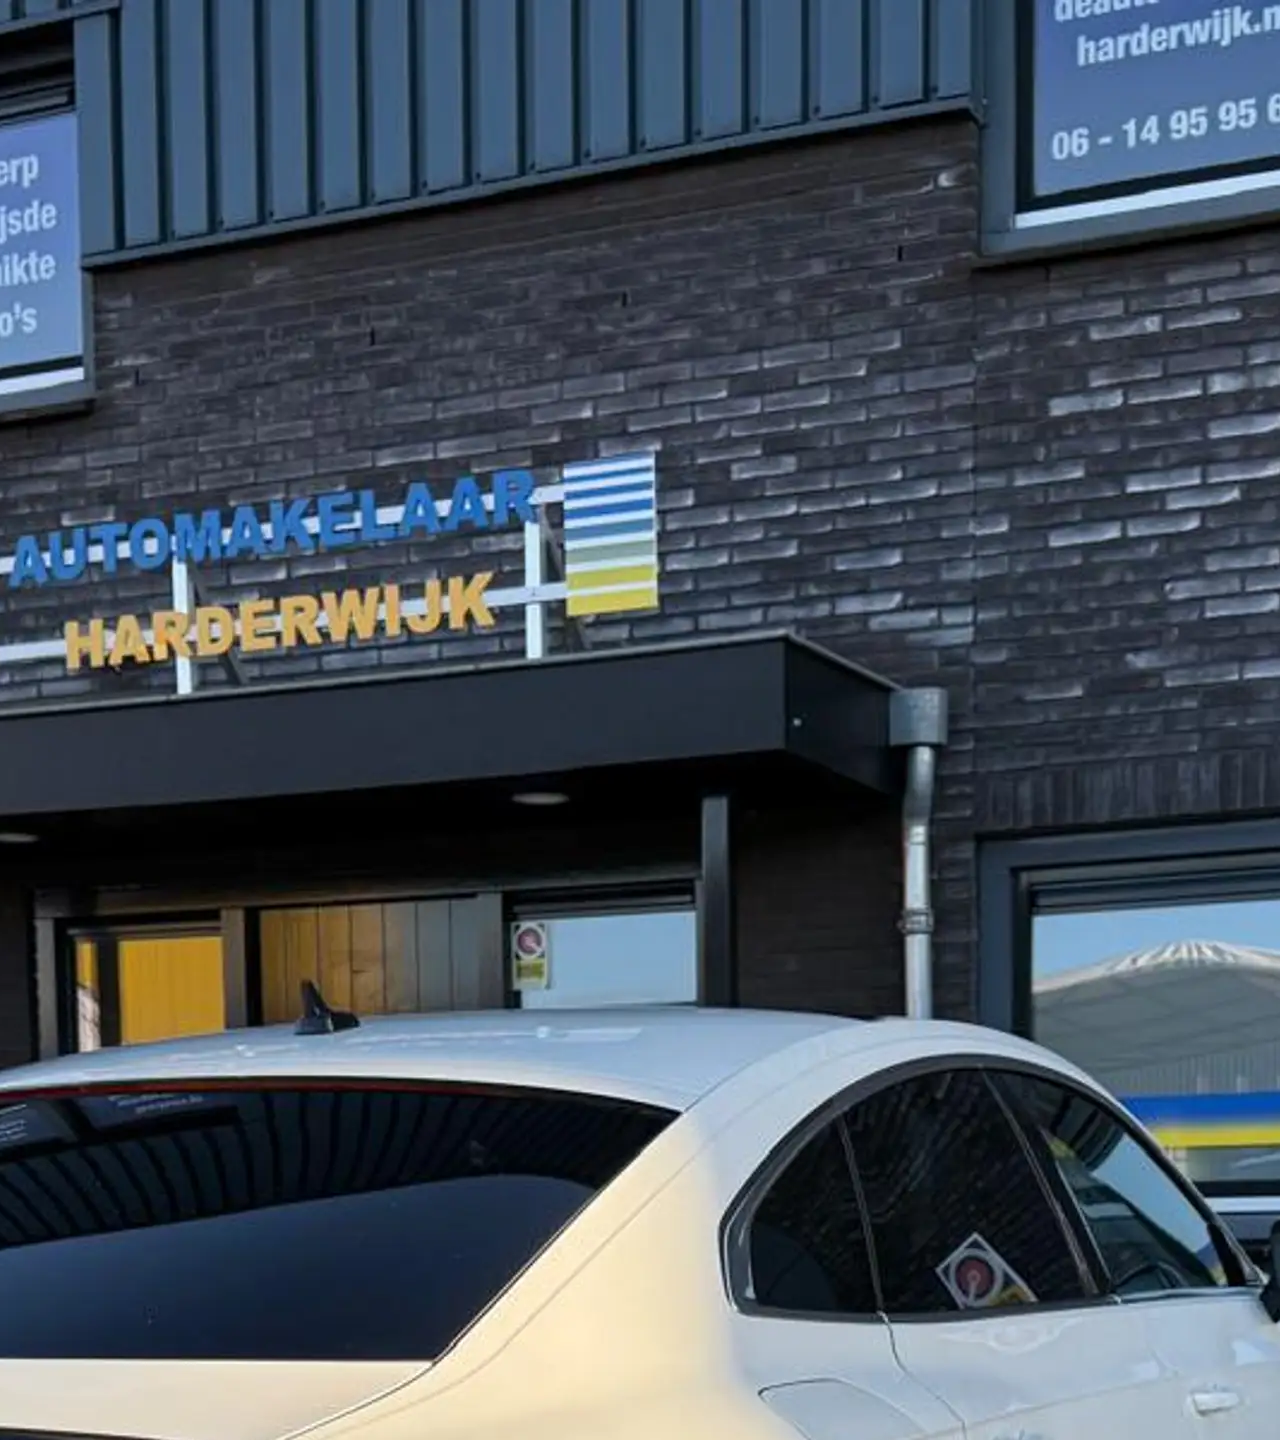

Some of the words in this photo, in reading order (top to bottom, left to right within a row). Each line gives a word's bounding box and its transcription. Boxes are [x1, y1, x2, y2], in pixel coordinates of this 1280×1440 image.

[1052, 127, 1090, 160] 06
[1122, 115, 1160, 149] 14
[1169, 106, 1208, 140] 95
[1219, 98, 1257, 132] 95
[7, 467, 537, 589] AUTOMAKELAAR
[65, 571, 496, 671] HARDERWIJK
